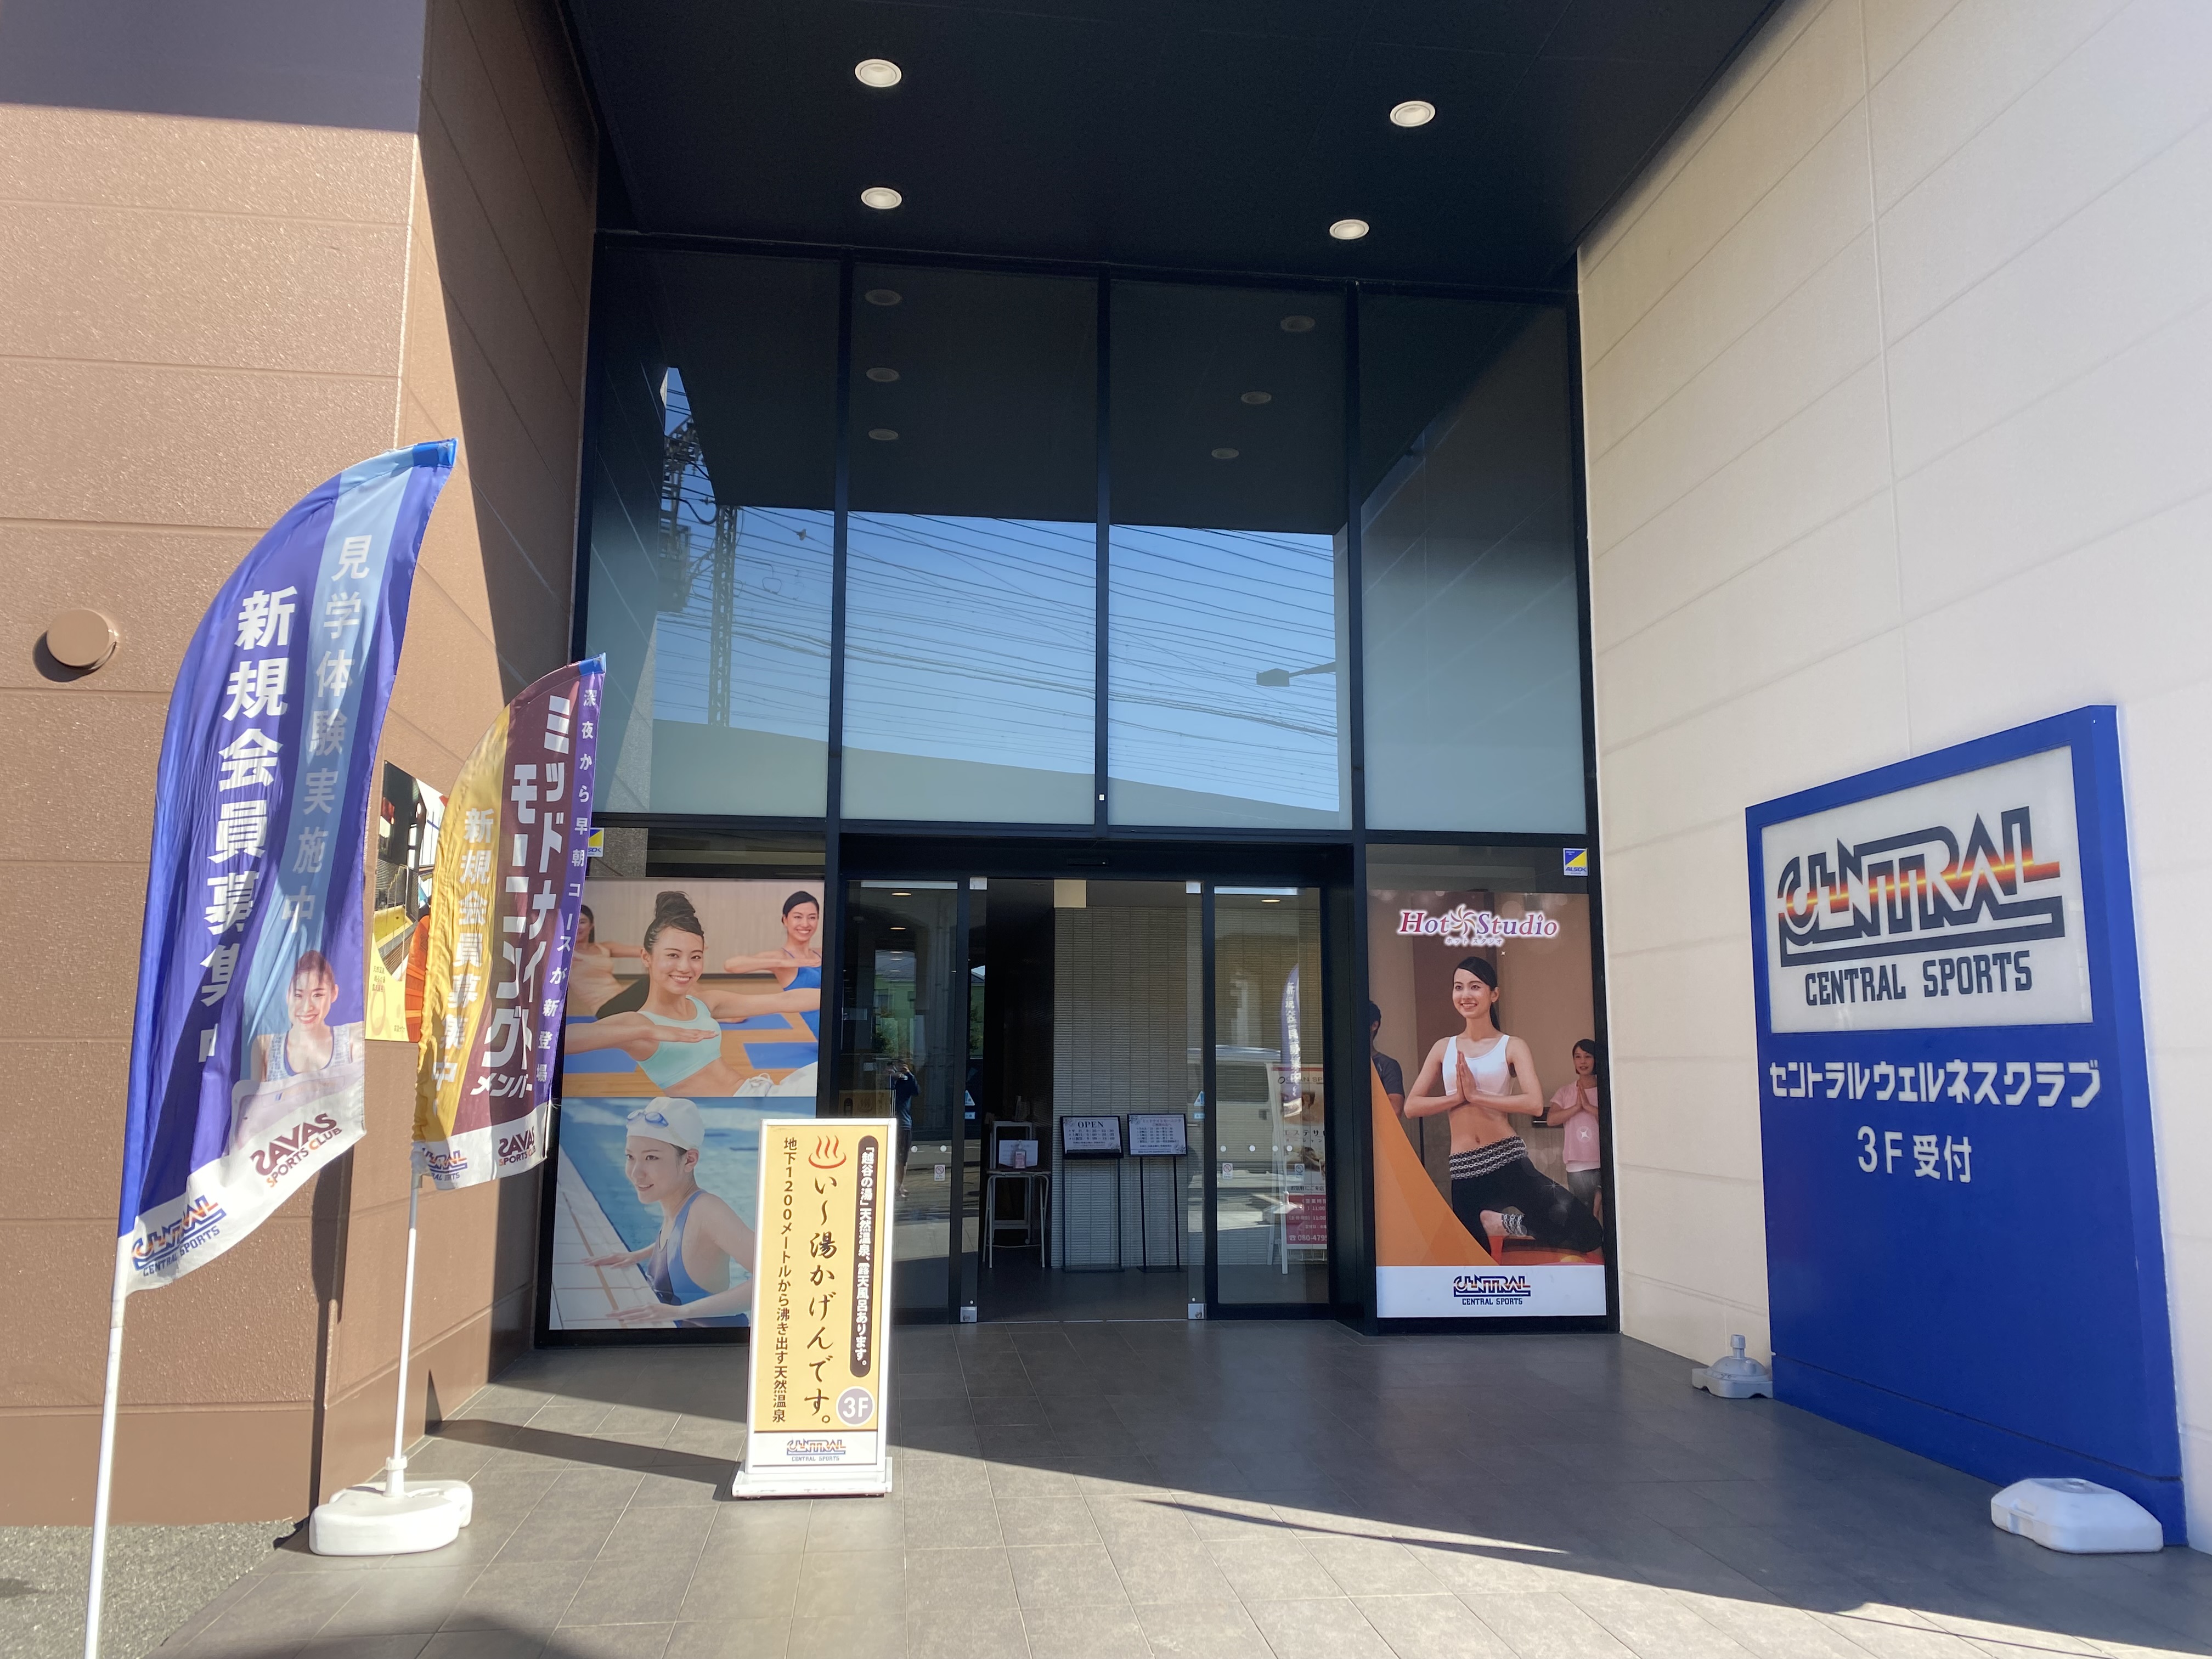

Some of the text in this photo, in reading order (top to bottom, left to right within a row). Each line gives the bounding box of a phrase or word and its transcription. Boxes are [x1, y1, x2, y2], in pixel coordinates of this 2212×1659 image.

[281, 534, 373, 933] 見学体験実施中
[521, 695, 571, 1070] ミッドナイト
[536, 689, 597, 1083] 深夜から早朝コースが新登場
[1777, 806, 2066, 968] CENTRAL
[481, 764, 538, 1069] モーニング
[1401, 912, 1559, 938] Hot Studio
[1805, 950, 2033, 1007] CENTRAL SPORTS
[470, 1073, 533, 1099] メンバー
[1769, 1058, 2101, 1109] セントラルウェルネスクラブ
[266, 1126, 343, 1188] SPORTS CLUB
[499, 1151, 528, 1166] SPORTS
[179, 1225, 221, 1257] SPORTS
[772, 1137, 797, 1423] 地下1200メートルから沸き出す天然温泉
[1453, 1273, 1531, 1297] CENTRAL
[842, 1397, 869, 1418] 3F
[786, 1438, 847, 1455] CENTRAL
